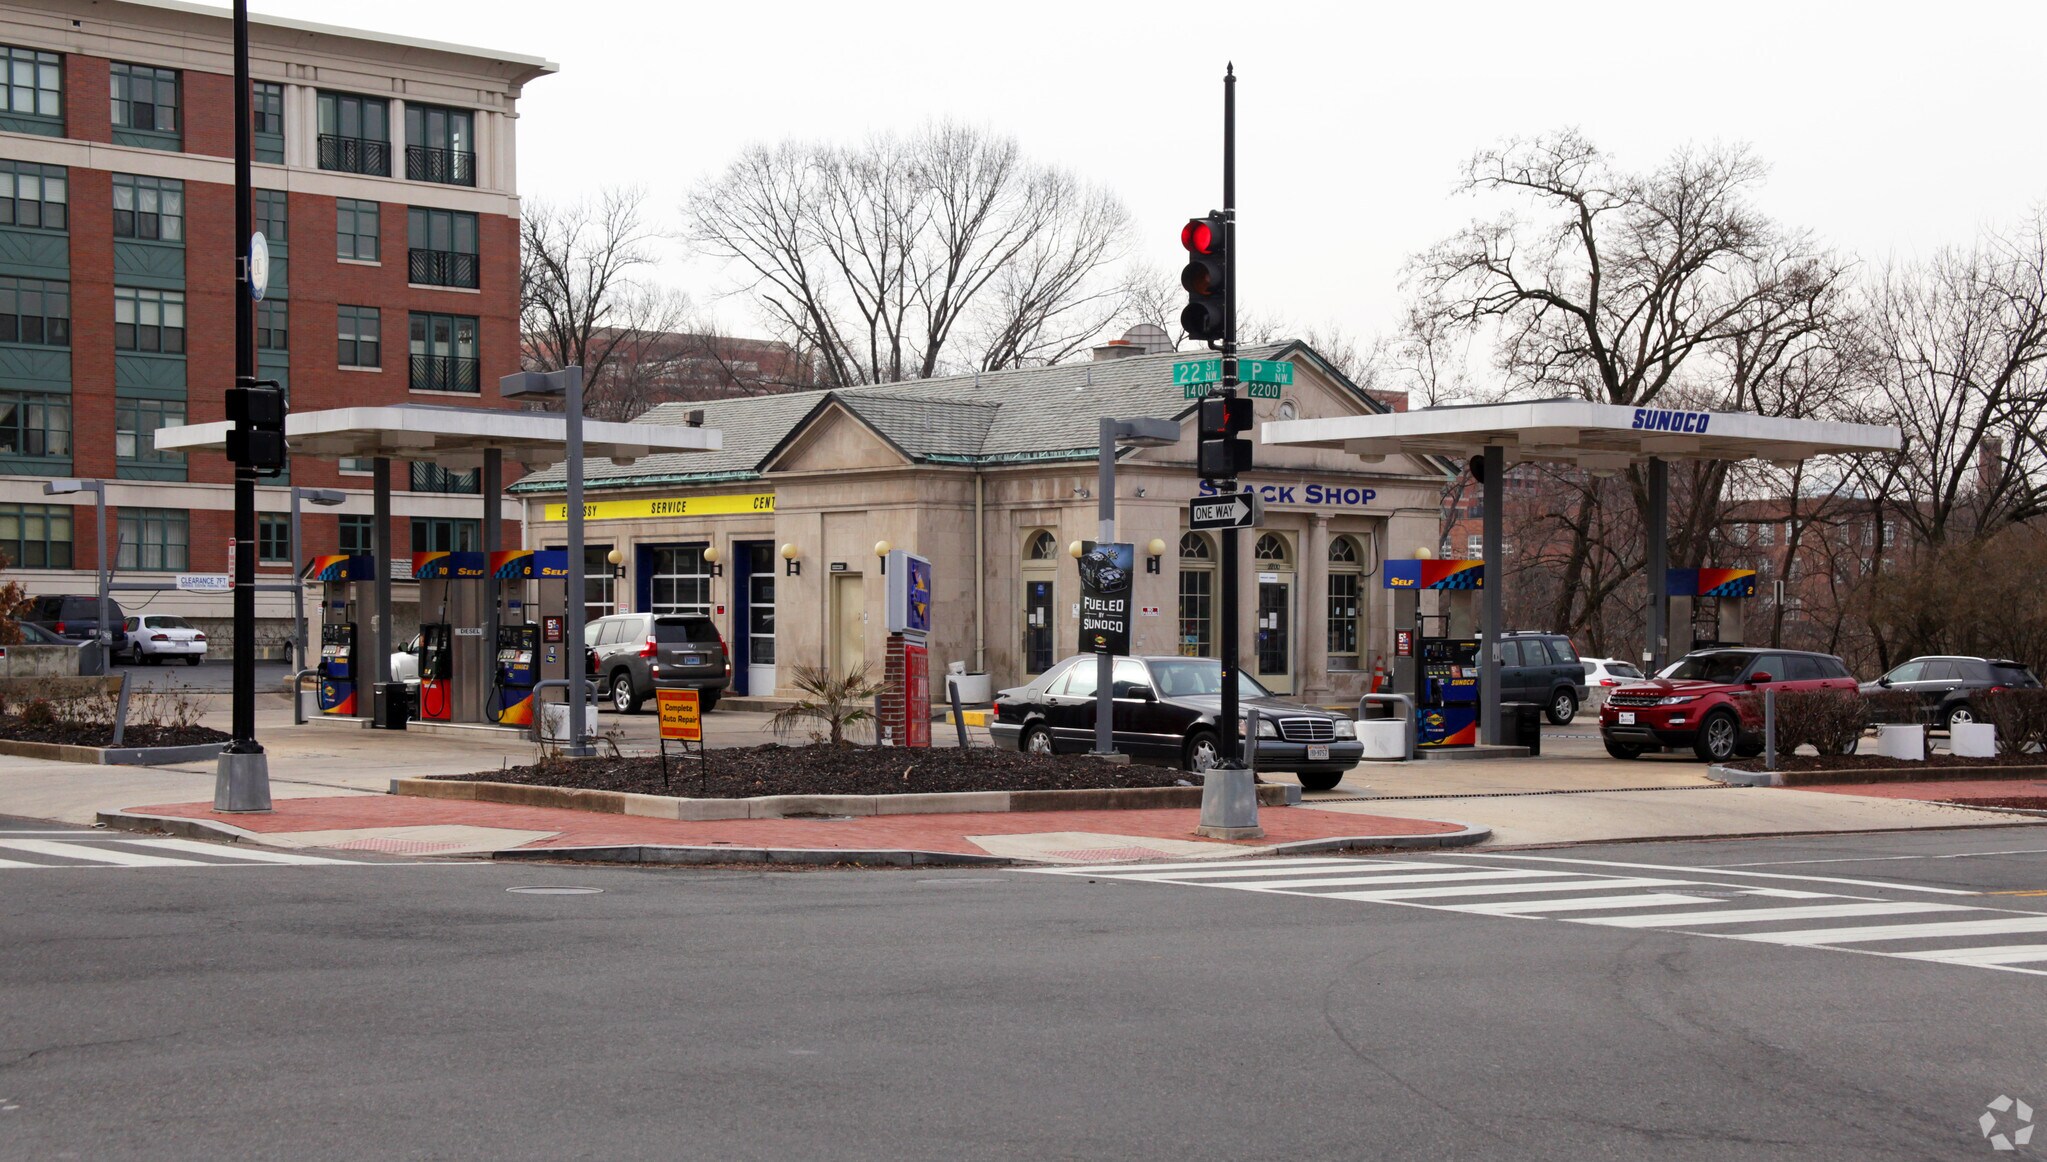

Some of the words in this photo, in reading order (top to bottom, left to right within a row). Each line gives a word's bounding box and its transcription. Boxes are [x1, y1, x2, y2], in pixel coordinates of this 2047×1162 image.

[1180, 363, 1200, 383] 22
[1206, 361, 1216, 371] ST
[1205, 371, 1217, 381] NW
[1252, 362, 1263, 380] P
[1276, 363, 1287, 373] ST
[1275, 373, 1288, 383] NW
[1186, 383, 1211, 398] 1400
[1251, 383, 1279, 397] 2200
[1632, 408, 1710, 433] SUNOCO
[1305, 484, 1376, 505] SHOP
[562, 505, 597, 518] ESSY
[651, 501, 687, 514] SERVICE
[1196, 506, 1213, 520] ONE
[1215, 504, 1235, 518] WAY
[340, 570, 347, 578] 8
[438, 566, 448, 576] 10
[523, 566, 531, 575] 6
[181, 576, 214, 585] CLEARANCE
[217, 577, 227, 585] 7FT
[1476, 577, 1483, 586] 4
[1747, 586, 1753, 595] 2
[1084, 596, 1124, 612] FUELED
[1084, 618, 1123, 633] SUNOCO
[664, 703, 693, 713] Complete
[662, 714, 677, 723] Auto
[677, 715, 698, 725] Repair
